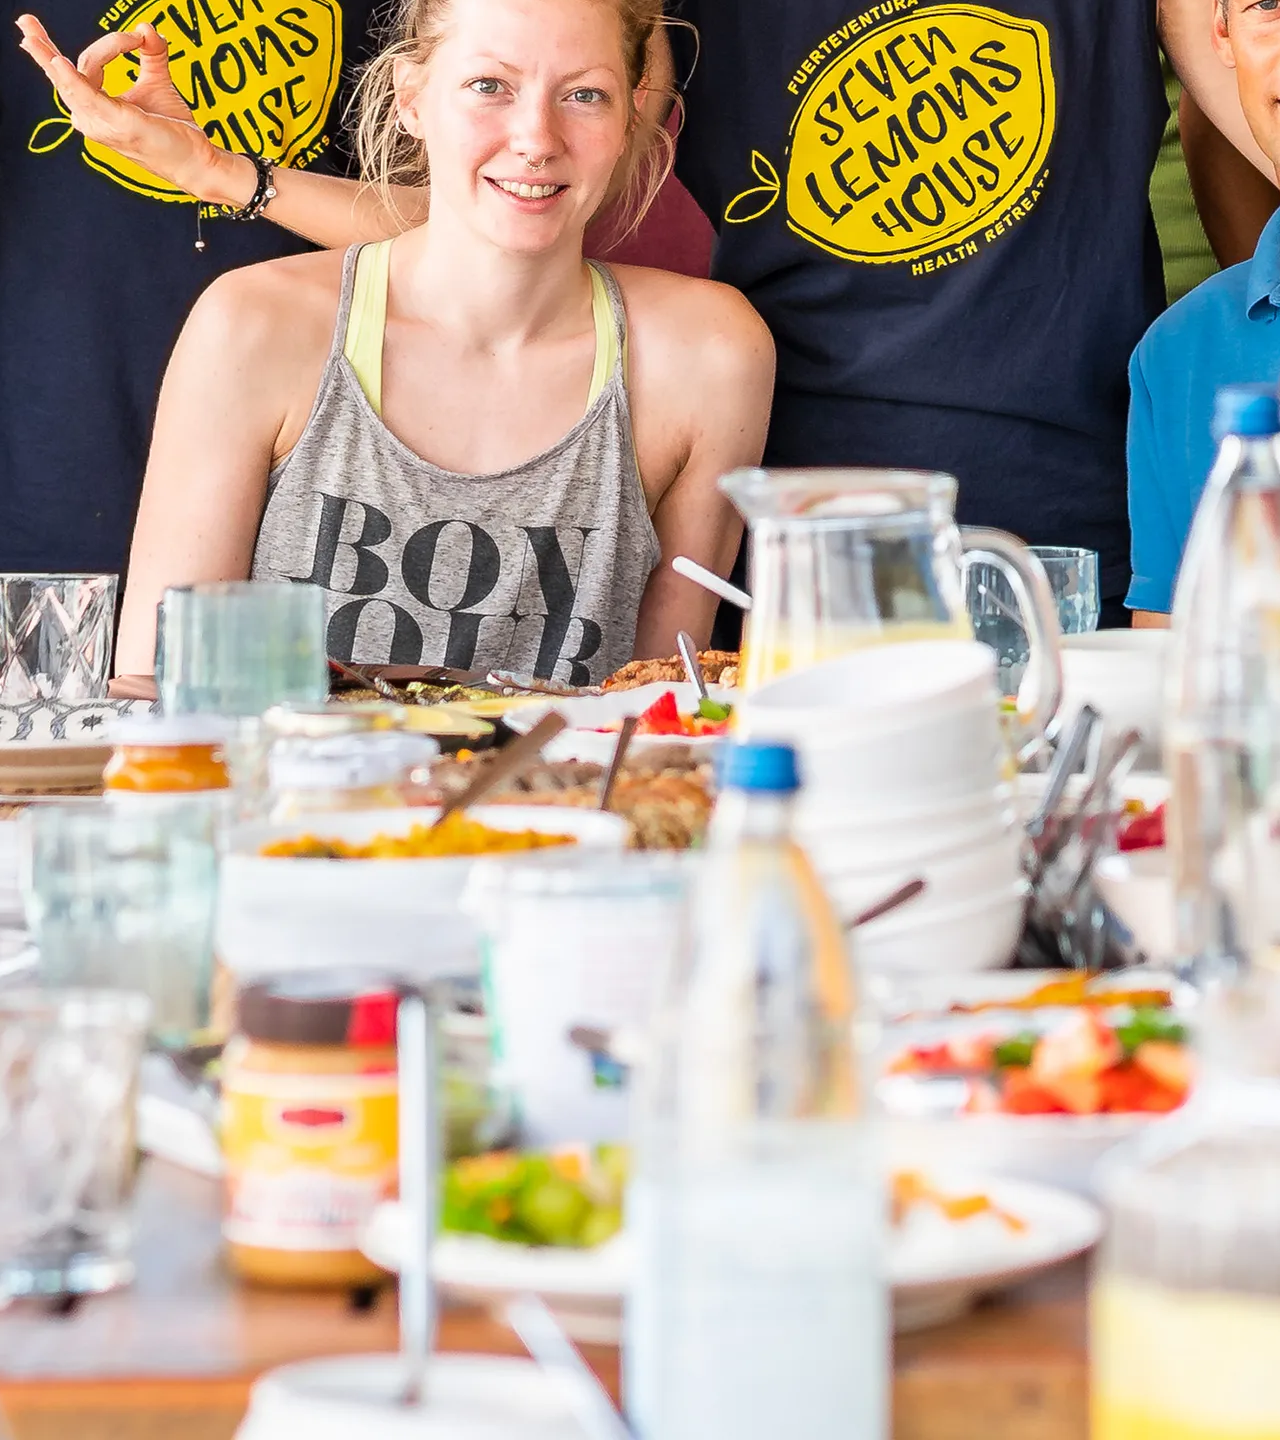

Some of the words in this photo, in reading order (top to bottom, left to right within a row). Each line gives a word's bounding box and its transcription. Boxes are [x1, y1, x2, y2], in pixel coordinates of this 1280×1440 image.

[173, 6, 320, 111] MONS
[813, 26, 958, 147] SEVEN
[202, 74, 313, 158] OUSE
[295, 134, 331, 169] EATS
[804, 40, 1022, 226] LEMONS
[871, 111, 1025, 237] HOUSE
[911, 241, 978, 276] HEALTH
[278, 491, 601, 617] BON
[326, 597, 603, 687] OUR
